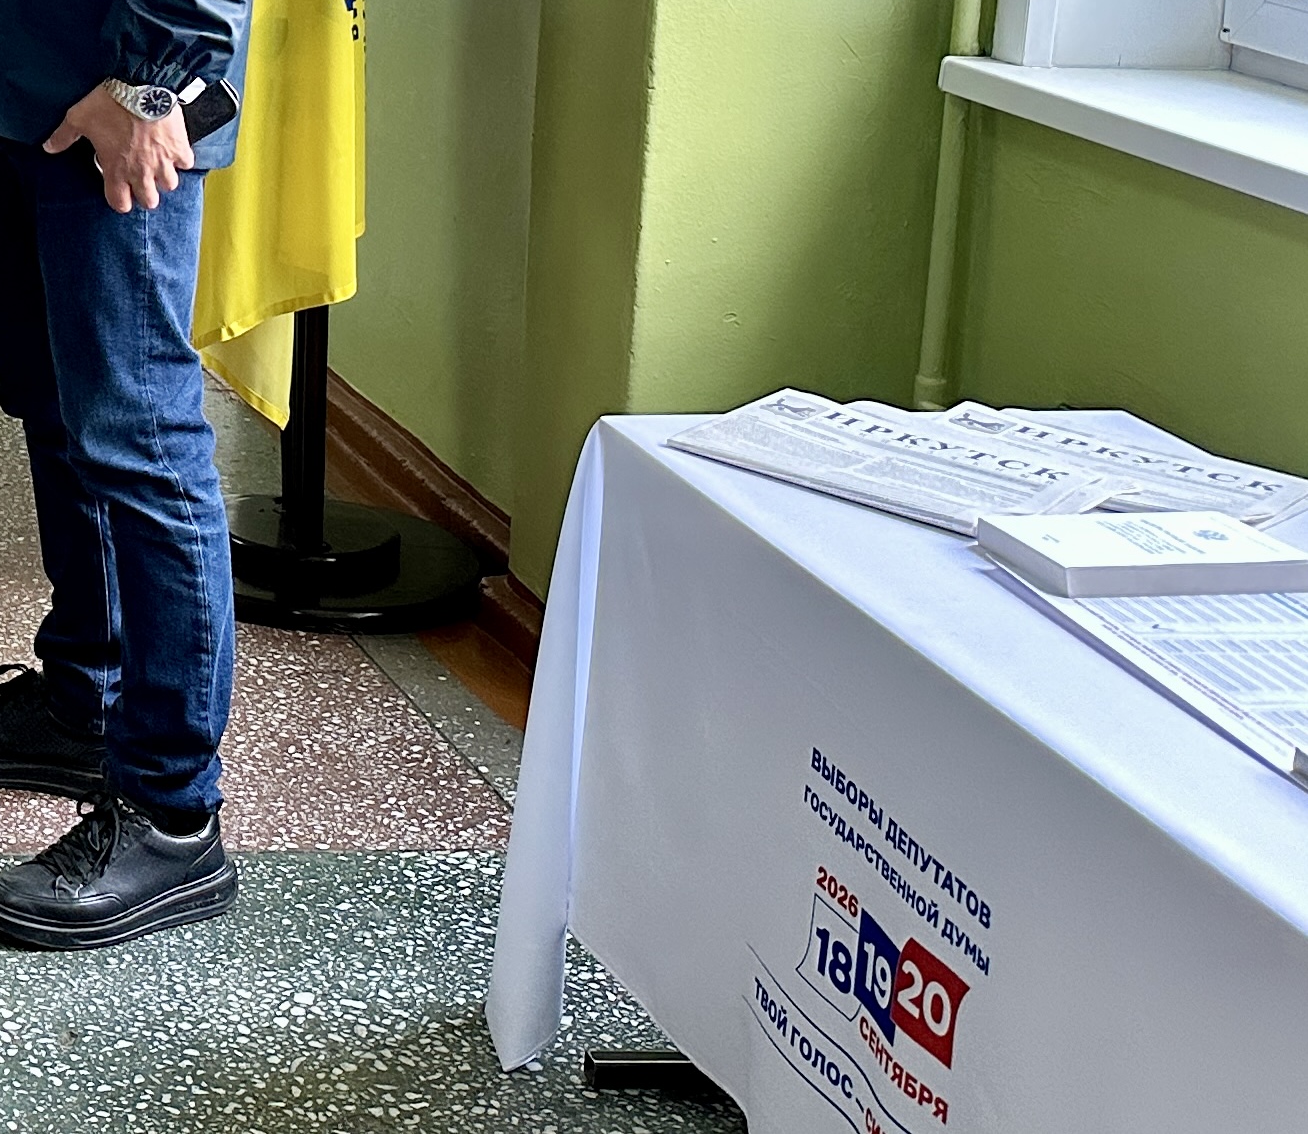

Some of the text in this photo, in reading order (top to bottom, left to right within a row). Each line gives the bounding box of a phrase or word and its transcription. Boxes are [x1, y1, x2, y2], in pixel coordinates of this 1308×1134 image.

[823, 411, 1069, 481] ИРКУТСК
[1015, 425, 1283, 492] ИРКУТСК
[803, 784, 990, 976] ГОСУДАРСТВЕННОЙ ДУМЫ
[811, 746, 991, 930] ВЫБОРЫ ДЕПУТАТОВ
[816, 865, 859, 919] 2026
[816, 927, 952, 1037] 18 19 20
[754, 976, 788, 1037] ТВОЙ
[789, 1025, 853, 1099] ГОЛОС
[865, 1107, 886, 1134] СИ
[859, 1015, 949, 1126] СЕНТЯБРЯ
